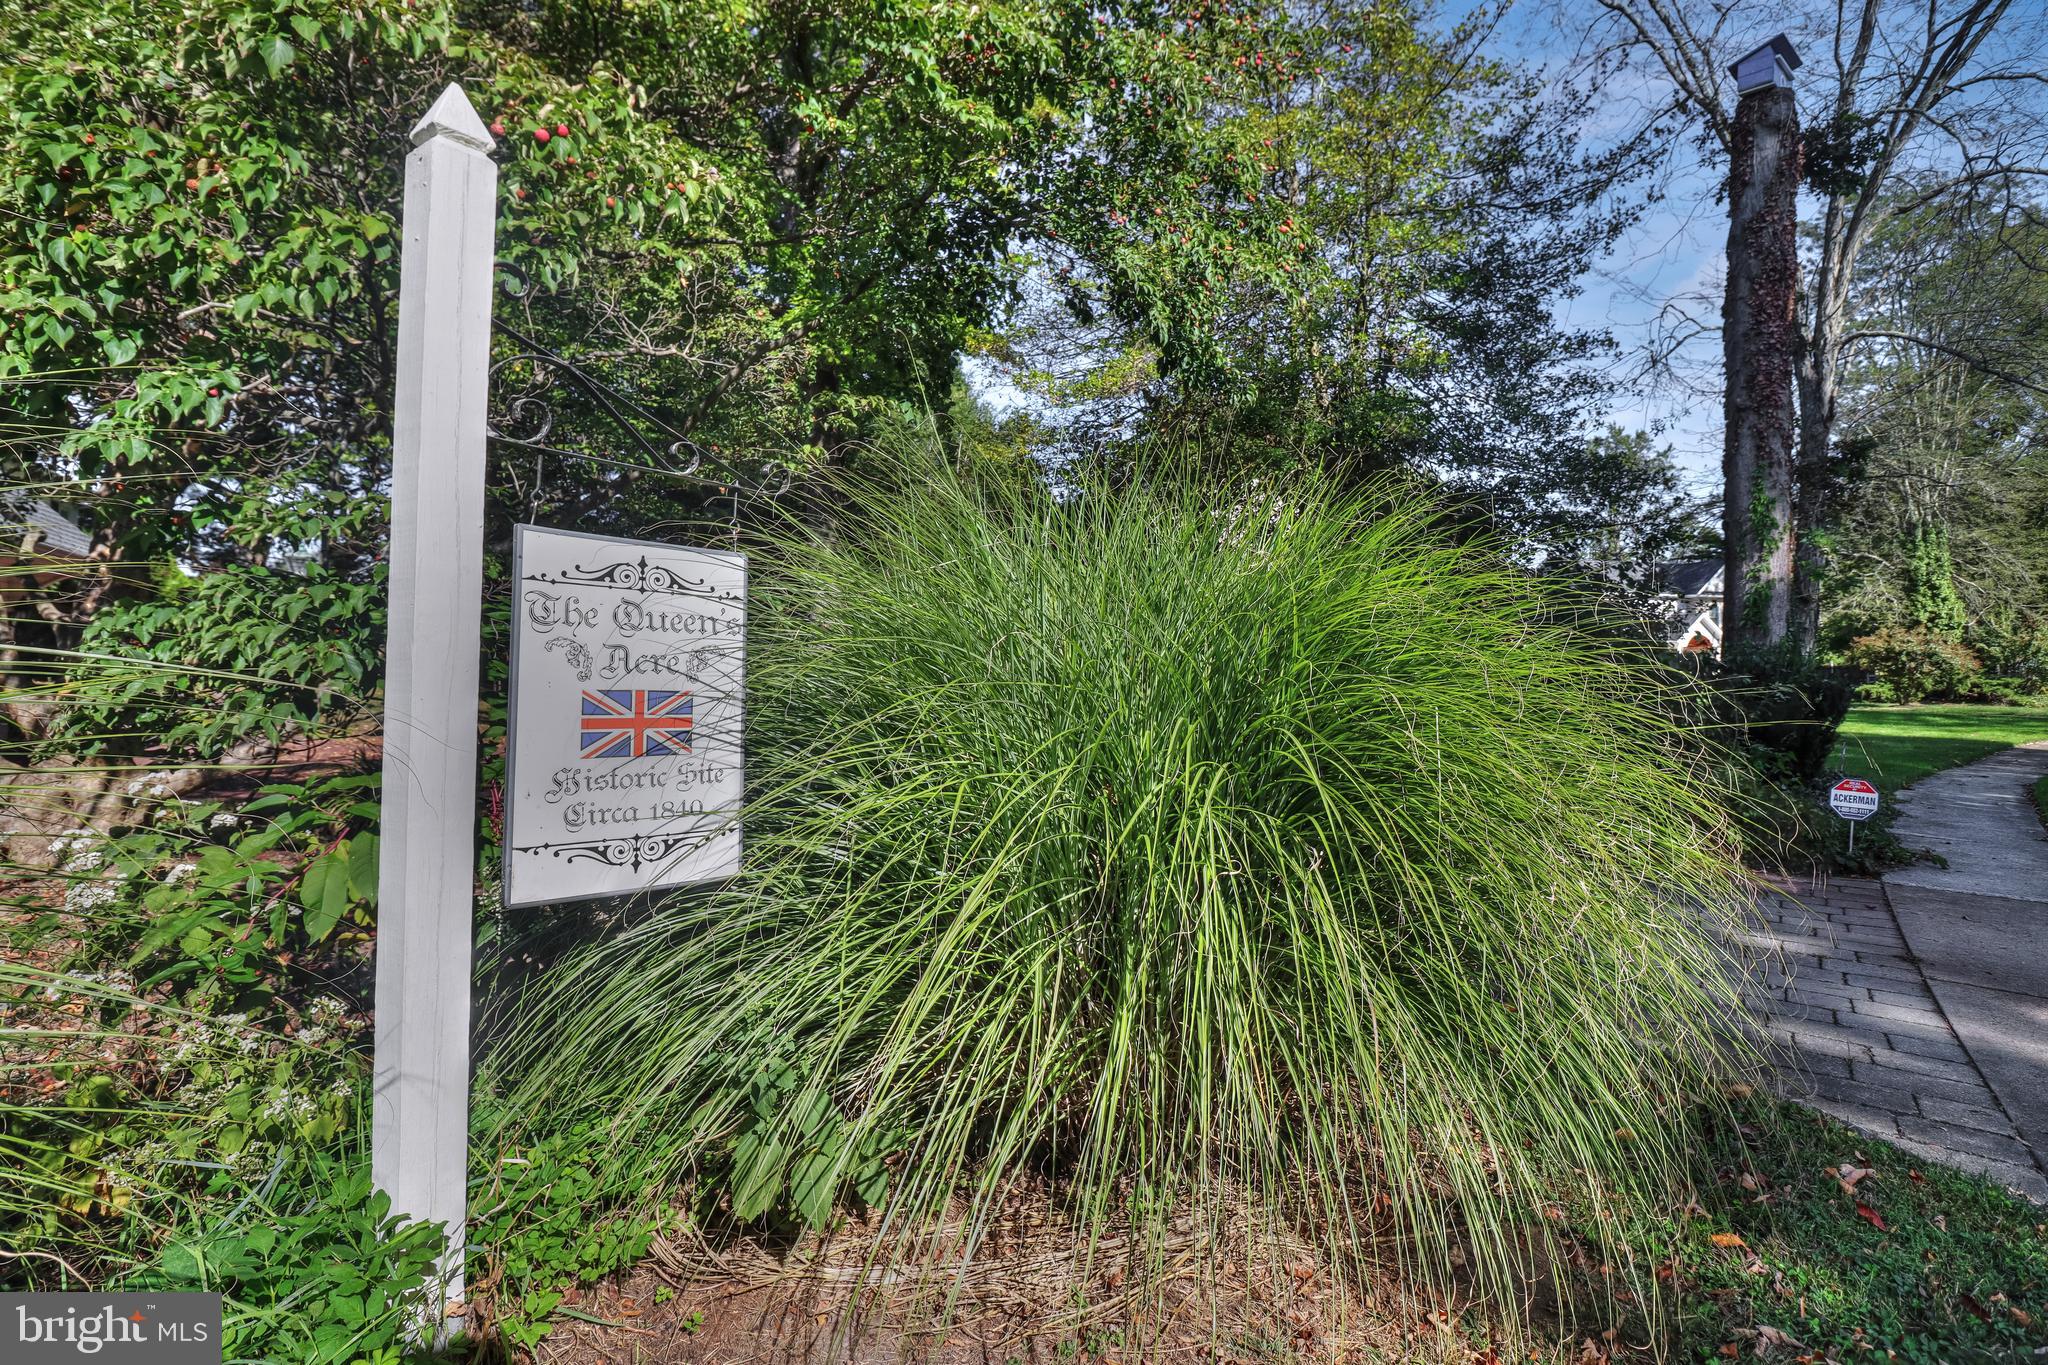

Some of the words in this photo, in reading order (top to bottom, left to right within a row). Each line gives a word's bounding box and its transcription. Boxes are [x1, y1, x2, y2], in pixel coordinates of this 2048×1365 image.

[524, 590, 599, 637] The
[613, 597, 742, 638] Queen's
[600, 643, 680, 680] Acre
[544, 767, 667, 804] Historic
[676, 762, 725, 792] Site
[1833, 794, 1876, 805] ACKERMAN
[563, 801, 639, 833] Circa
[650, 799, 704, 821] 1840
